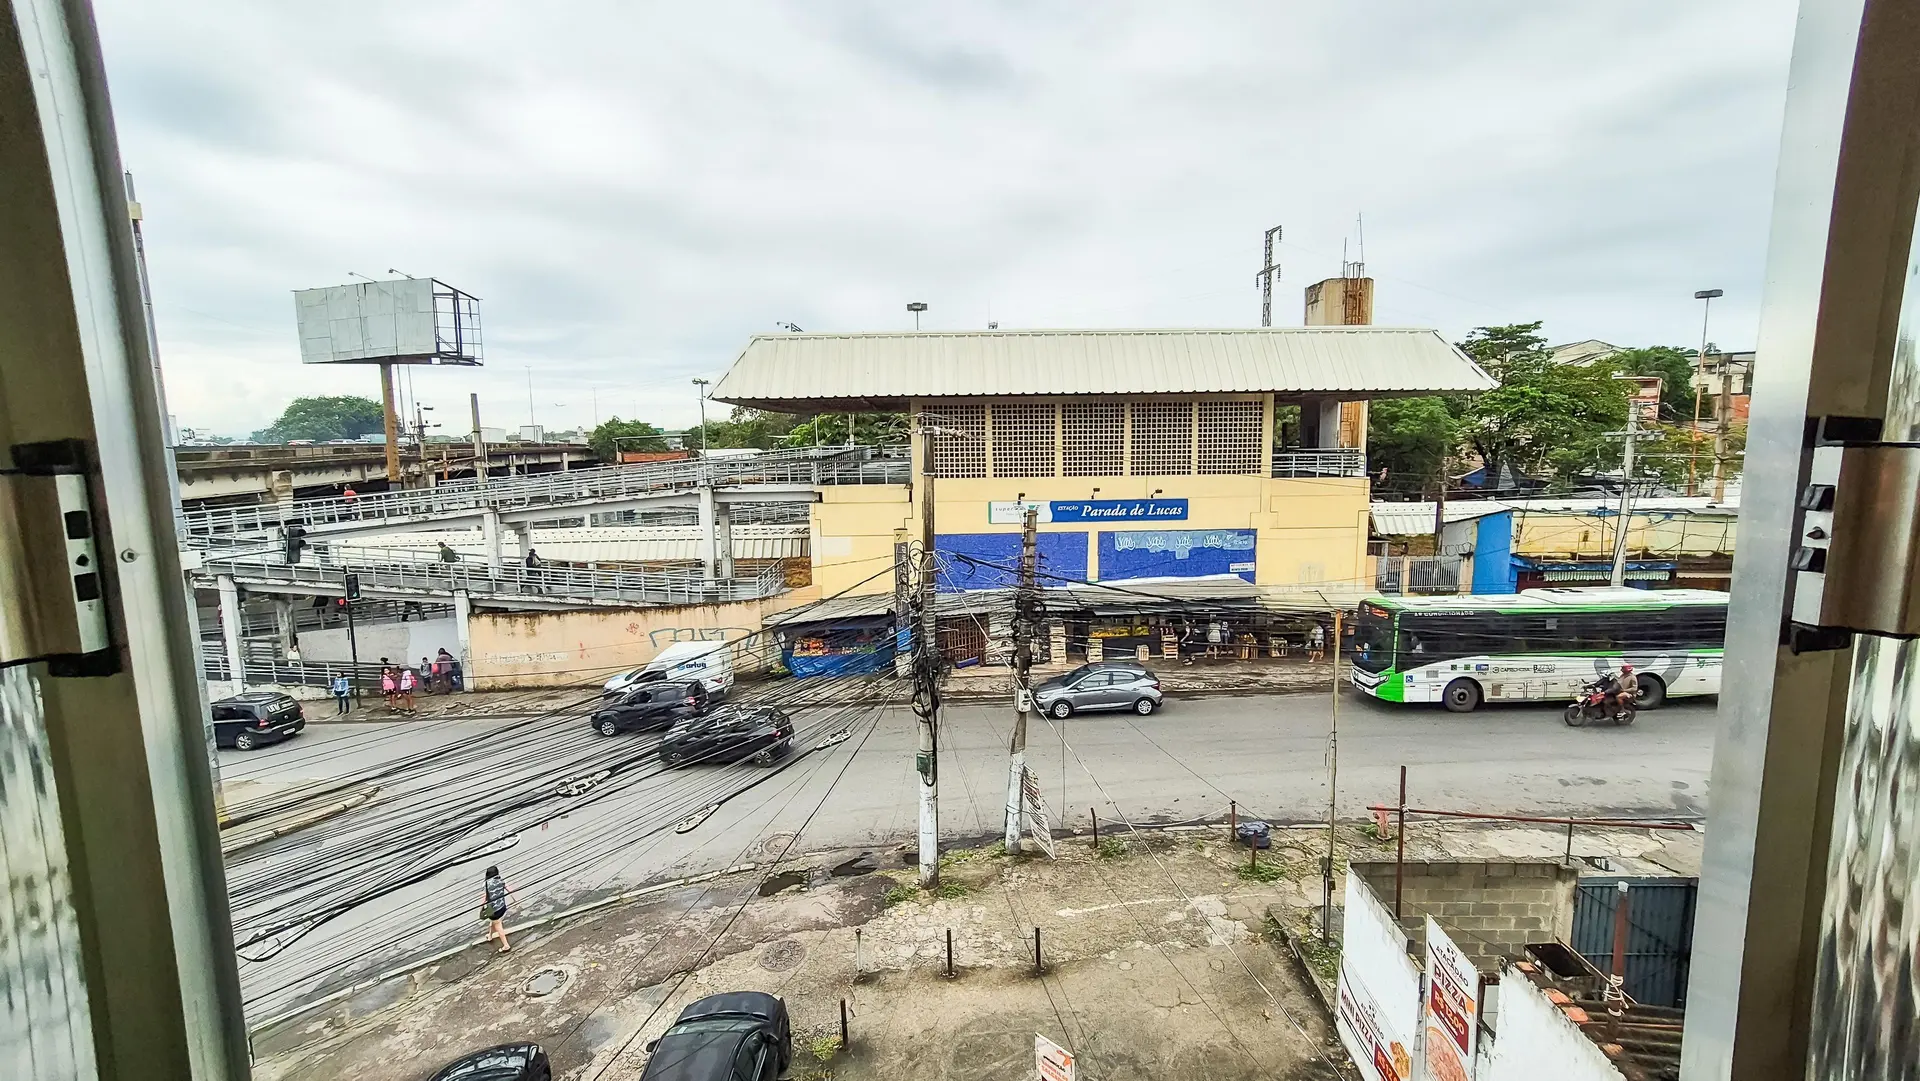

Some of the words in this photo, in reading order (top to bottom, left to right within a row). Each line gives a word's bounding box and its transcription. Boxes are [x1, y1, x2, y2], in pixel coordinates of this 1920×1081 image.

[1081, 504, 1126, 517] Parada
[1129, 504, 1145, 516] de
[1147, 504, 1183, 516] Lucas
[1434, 963, 1468, 1014] PIZZA
[1355, 1013, 1374, 1050] PIZZA
